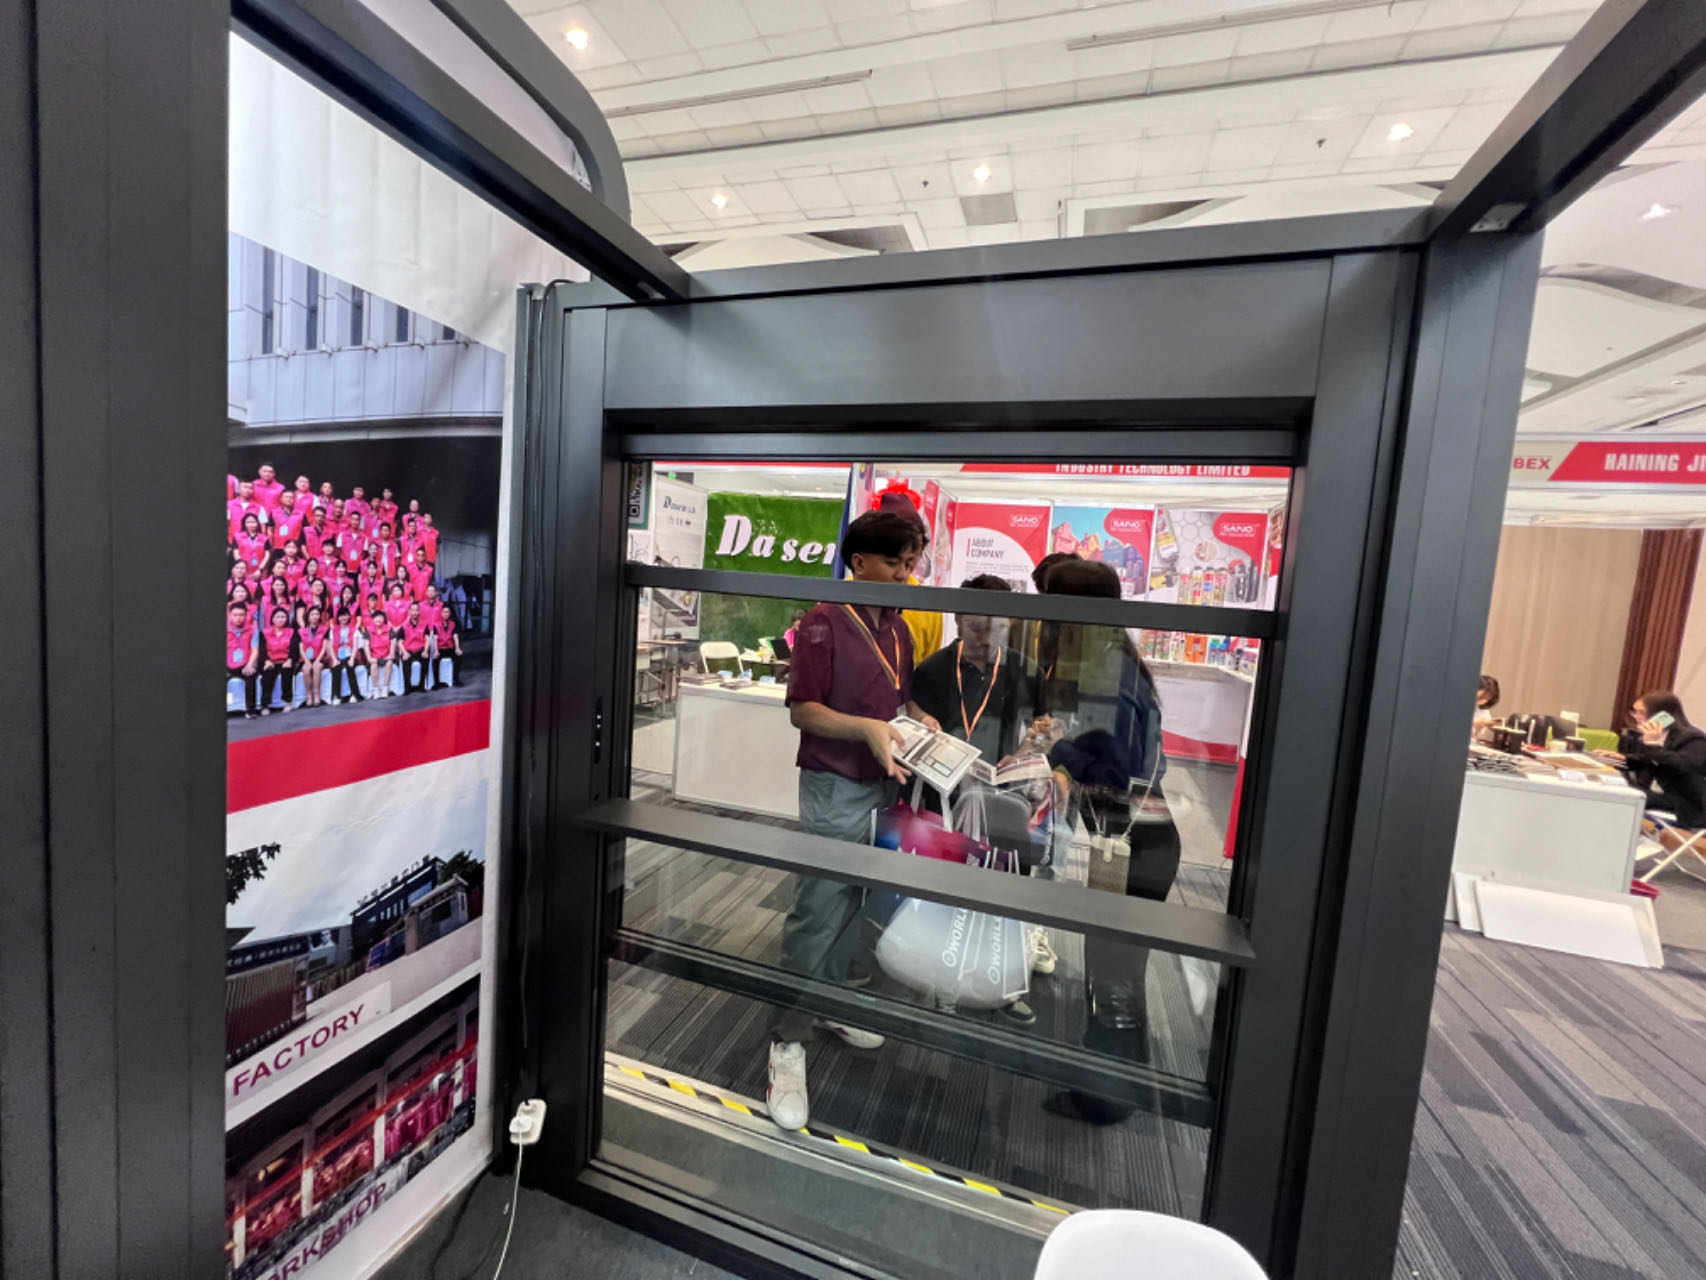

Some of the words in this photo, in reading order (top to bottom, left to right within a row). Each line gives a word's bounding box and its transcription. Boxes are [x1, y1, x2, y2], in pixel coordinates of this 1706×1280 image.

[1604, 453, 1680, 472] HAINING
[1056, 464, 1113, 473] INDUSTRY
[1119, 464, 1191, 475] TECHNOLOGY
[1196, 465, 1250, 476] LIMITED
[971, 539, 994, 548] ABOUT
[971, 549, 1004, 558] COMPANY
[233, 1004, 365, 1096] FACTORY
